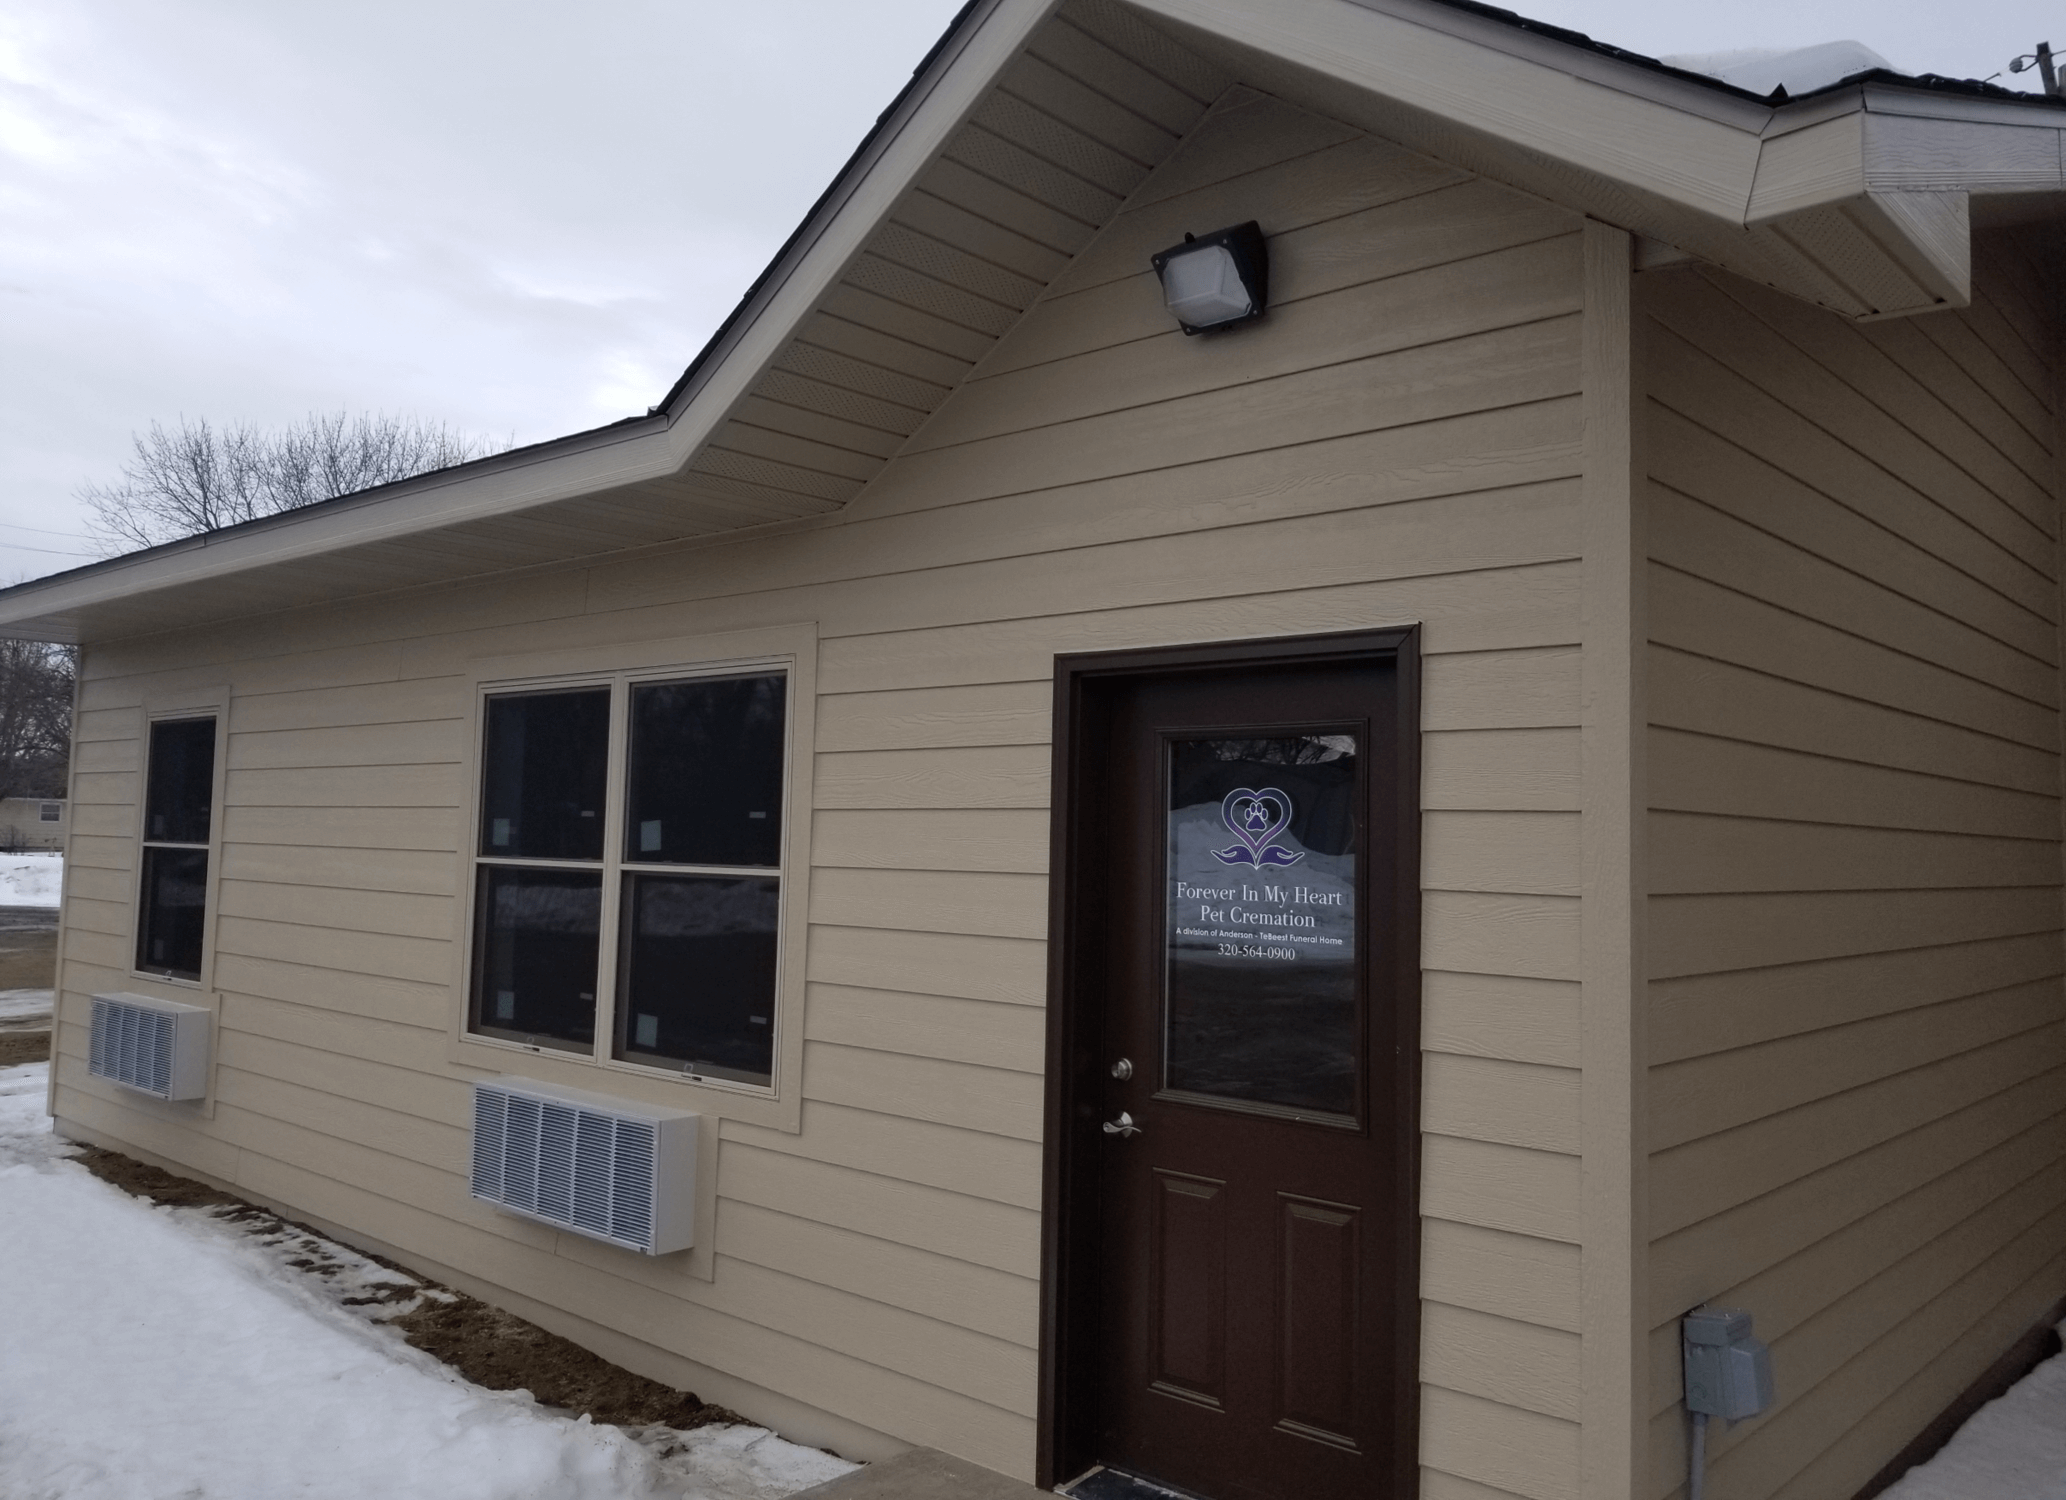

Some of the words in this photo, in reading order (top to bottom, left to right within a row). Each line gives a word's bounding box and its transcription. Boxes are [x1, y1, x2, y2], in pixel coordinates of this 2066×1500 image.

[1177, 882, 1236, 900] Forever
[1242, 885, 1258, 901] In
[1264, 886, 1288, 908] My
[1294, 887, 1342, 905] Heart
[1200, 906, 1224, 922] Pet
[1230, 906, 1315, 927] Cremation
[1219, 930, 1253, 939] Anderson
[1260, 932, 1288, 941] TeBeest
[1290, 934, 1317, 943] Funeral
[1320, 936, 1342, 944] Home
[1218, 944, 1295, 960] 320-564-0900
